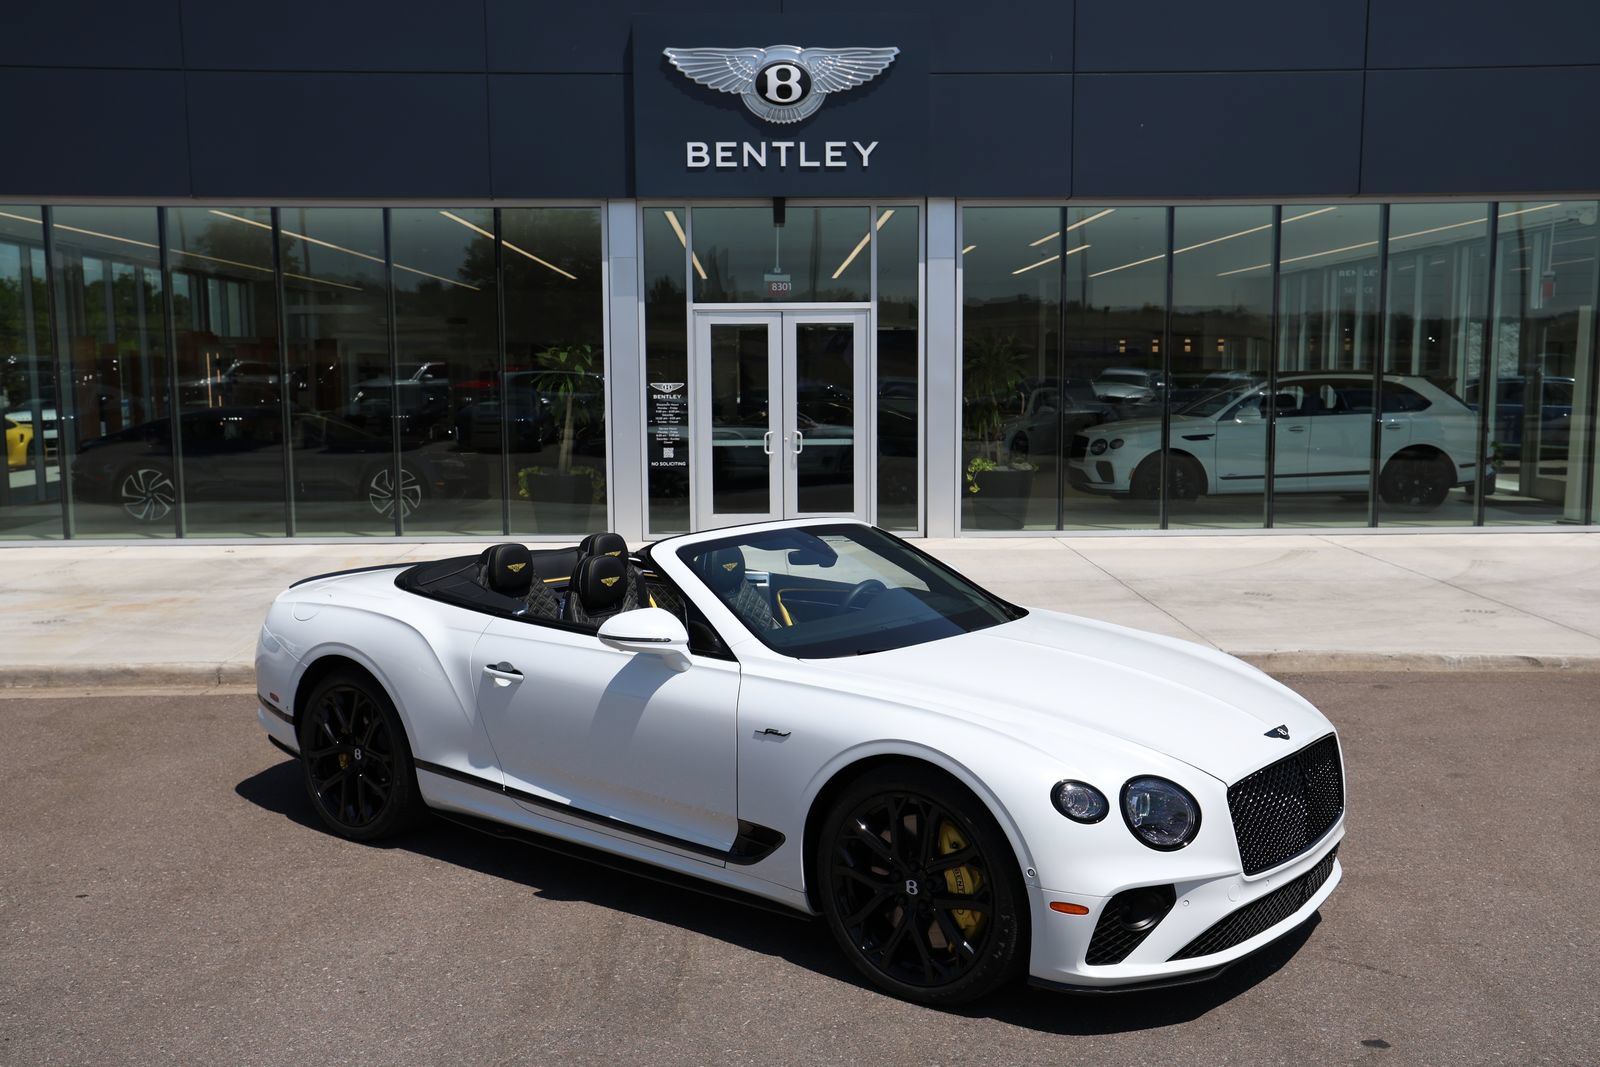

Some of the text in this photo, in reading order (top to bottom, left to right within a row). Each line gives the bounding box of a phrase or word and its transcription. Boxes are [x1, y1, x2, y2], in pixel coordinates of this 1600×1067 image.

[764, 64, 803, 103] B
[686, 141, 879, 168] BENTLEY
[1338, 269, 1378, 277] BENLE
[771, 282, 792, 291] 8301
[905, 879, 919, 895] B
